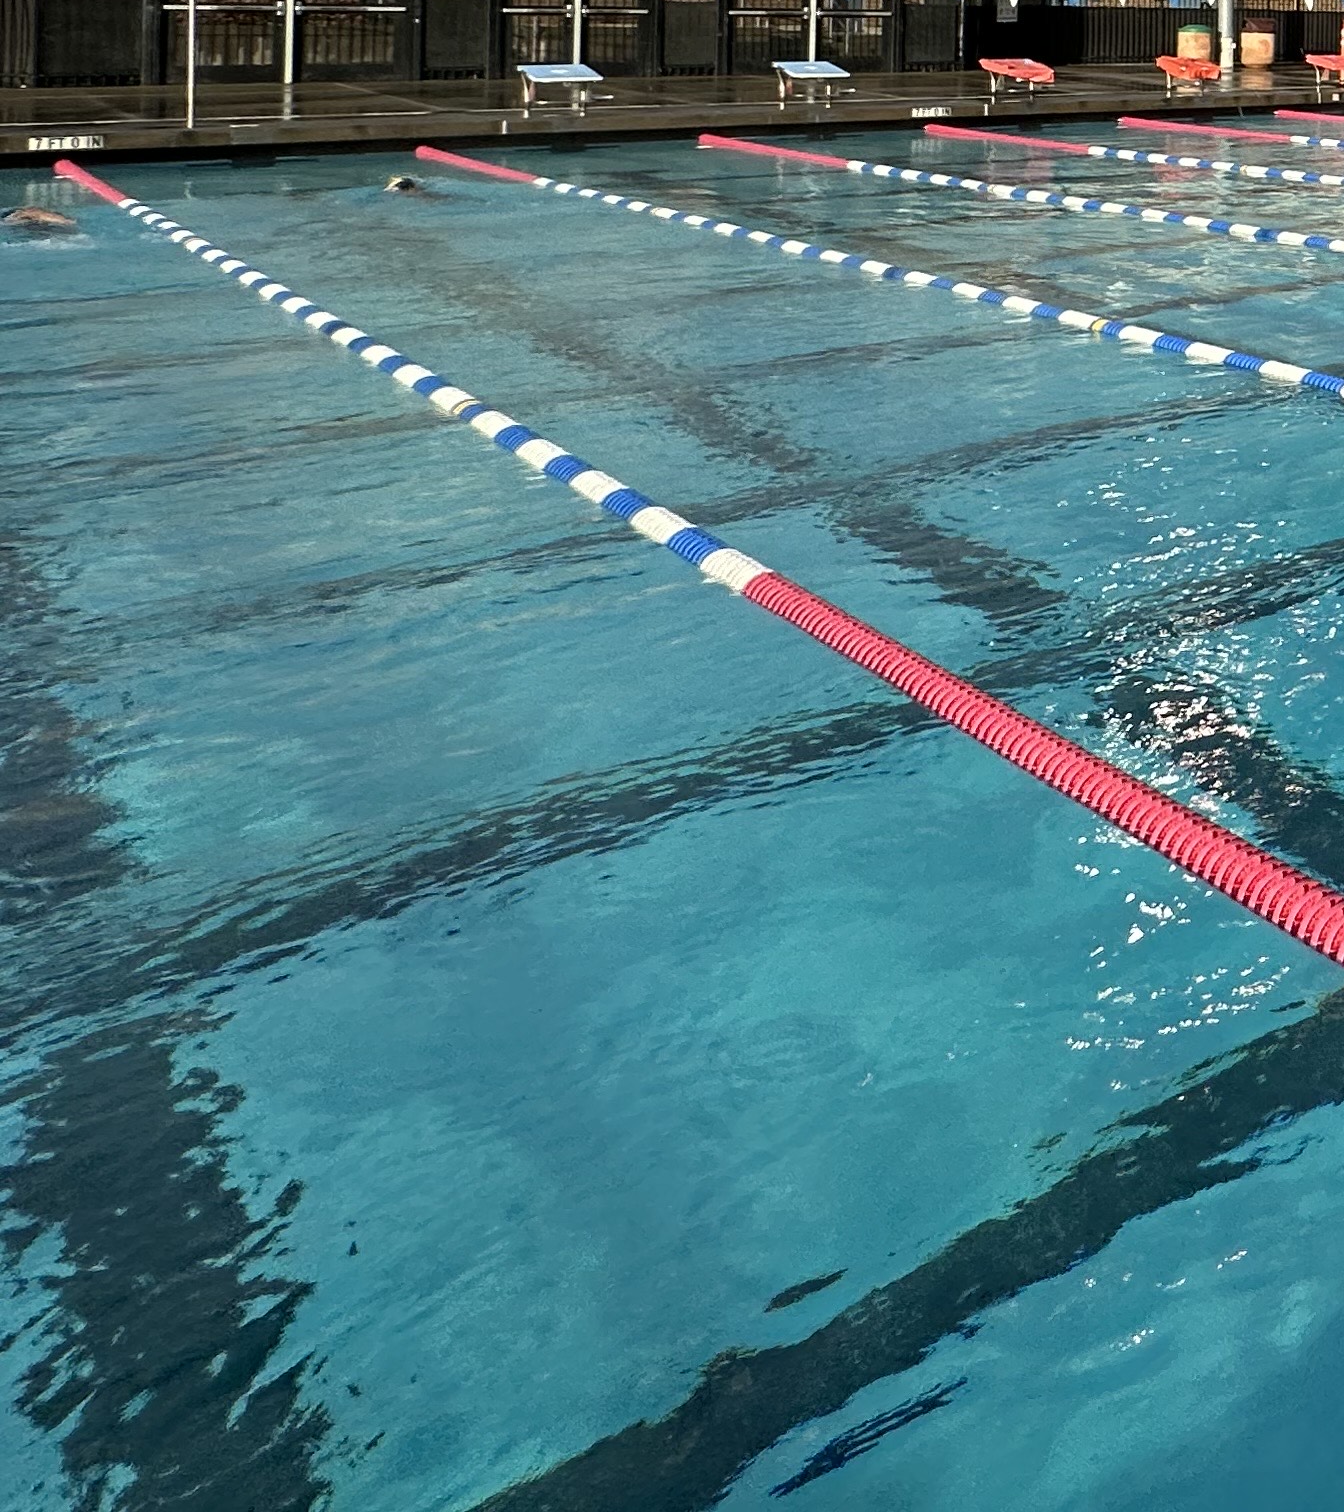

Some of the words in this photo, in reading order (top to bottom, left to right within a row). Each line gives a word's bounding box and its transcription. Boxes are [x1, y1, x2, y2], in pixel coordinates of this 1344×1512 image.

[34, 136, 43, 149] 7
[48, 136, 66, 149] FT
[87, 135, 101, 148] IN
